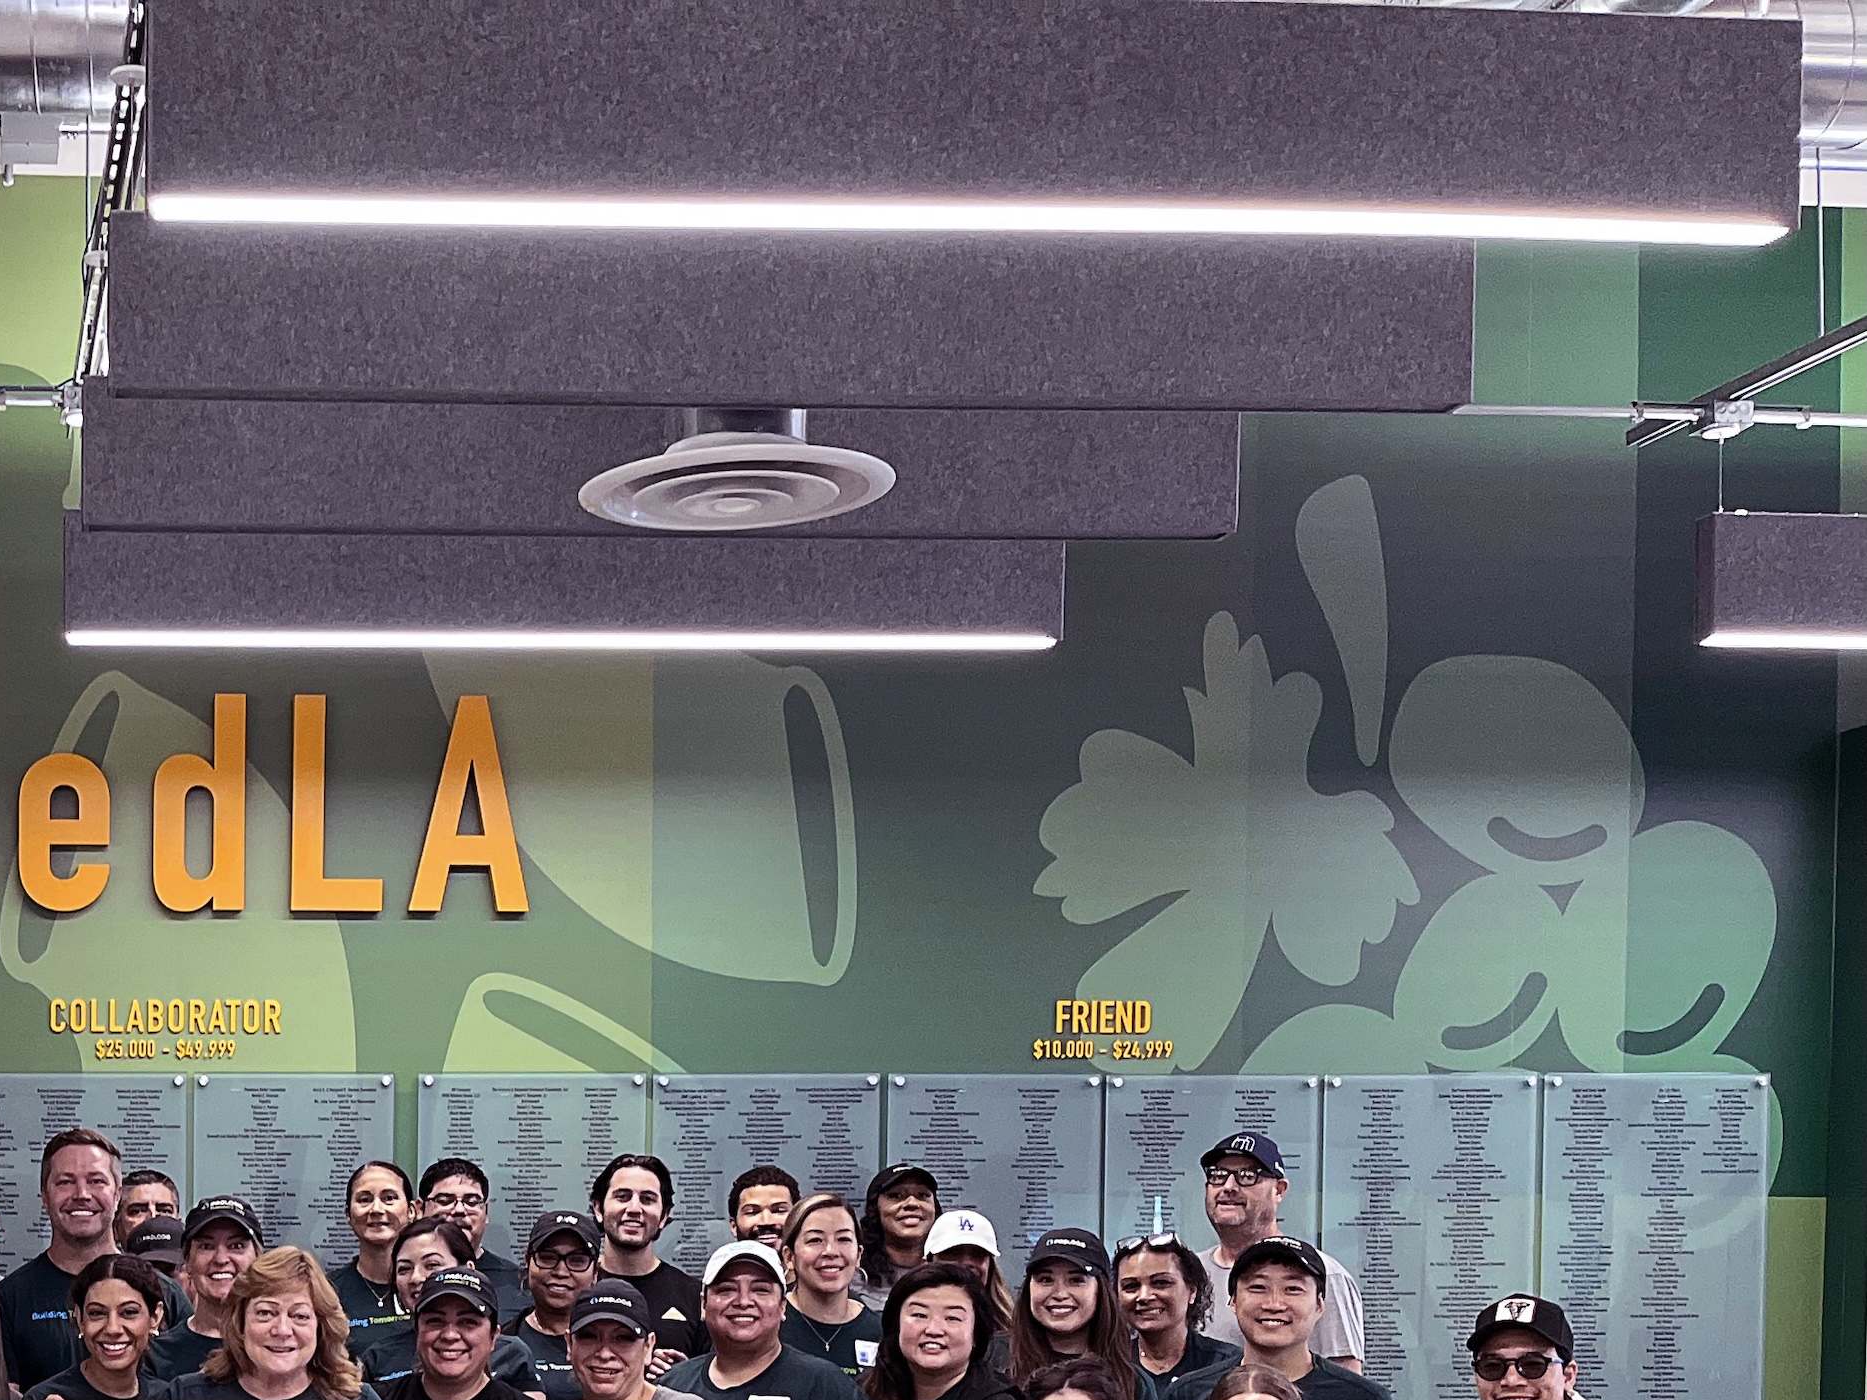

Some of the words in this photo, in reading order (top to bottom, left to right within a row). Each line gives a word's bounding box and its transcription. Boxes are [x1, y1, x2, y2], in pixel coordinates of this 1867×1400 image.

[50, 998, 282, 1034] COLLABORATOR
[1056, 1000, 1152, 1034] FRIEND
[958, 1216, 974, 1231] LA
